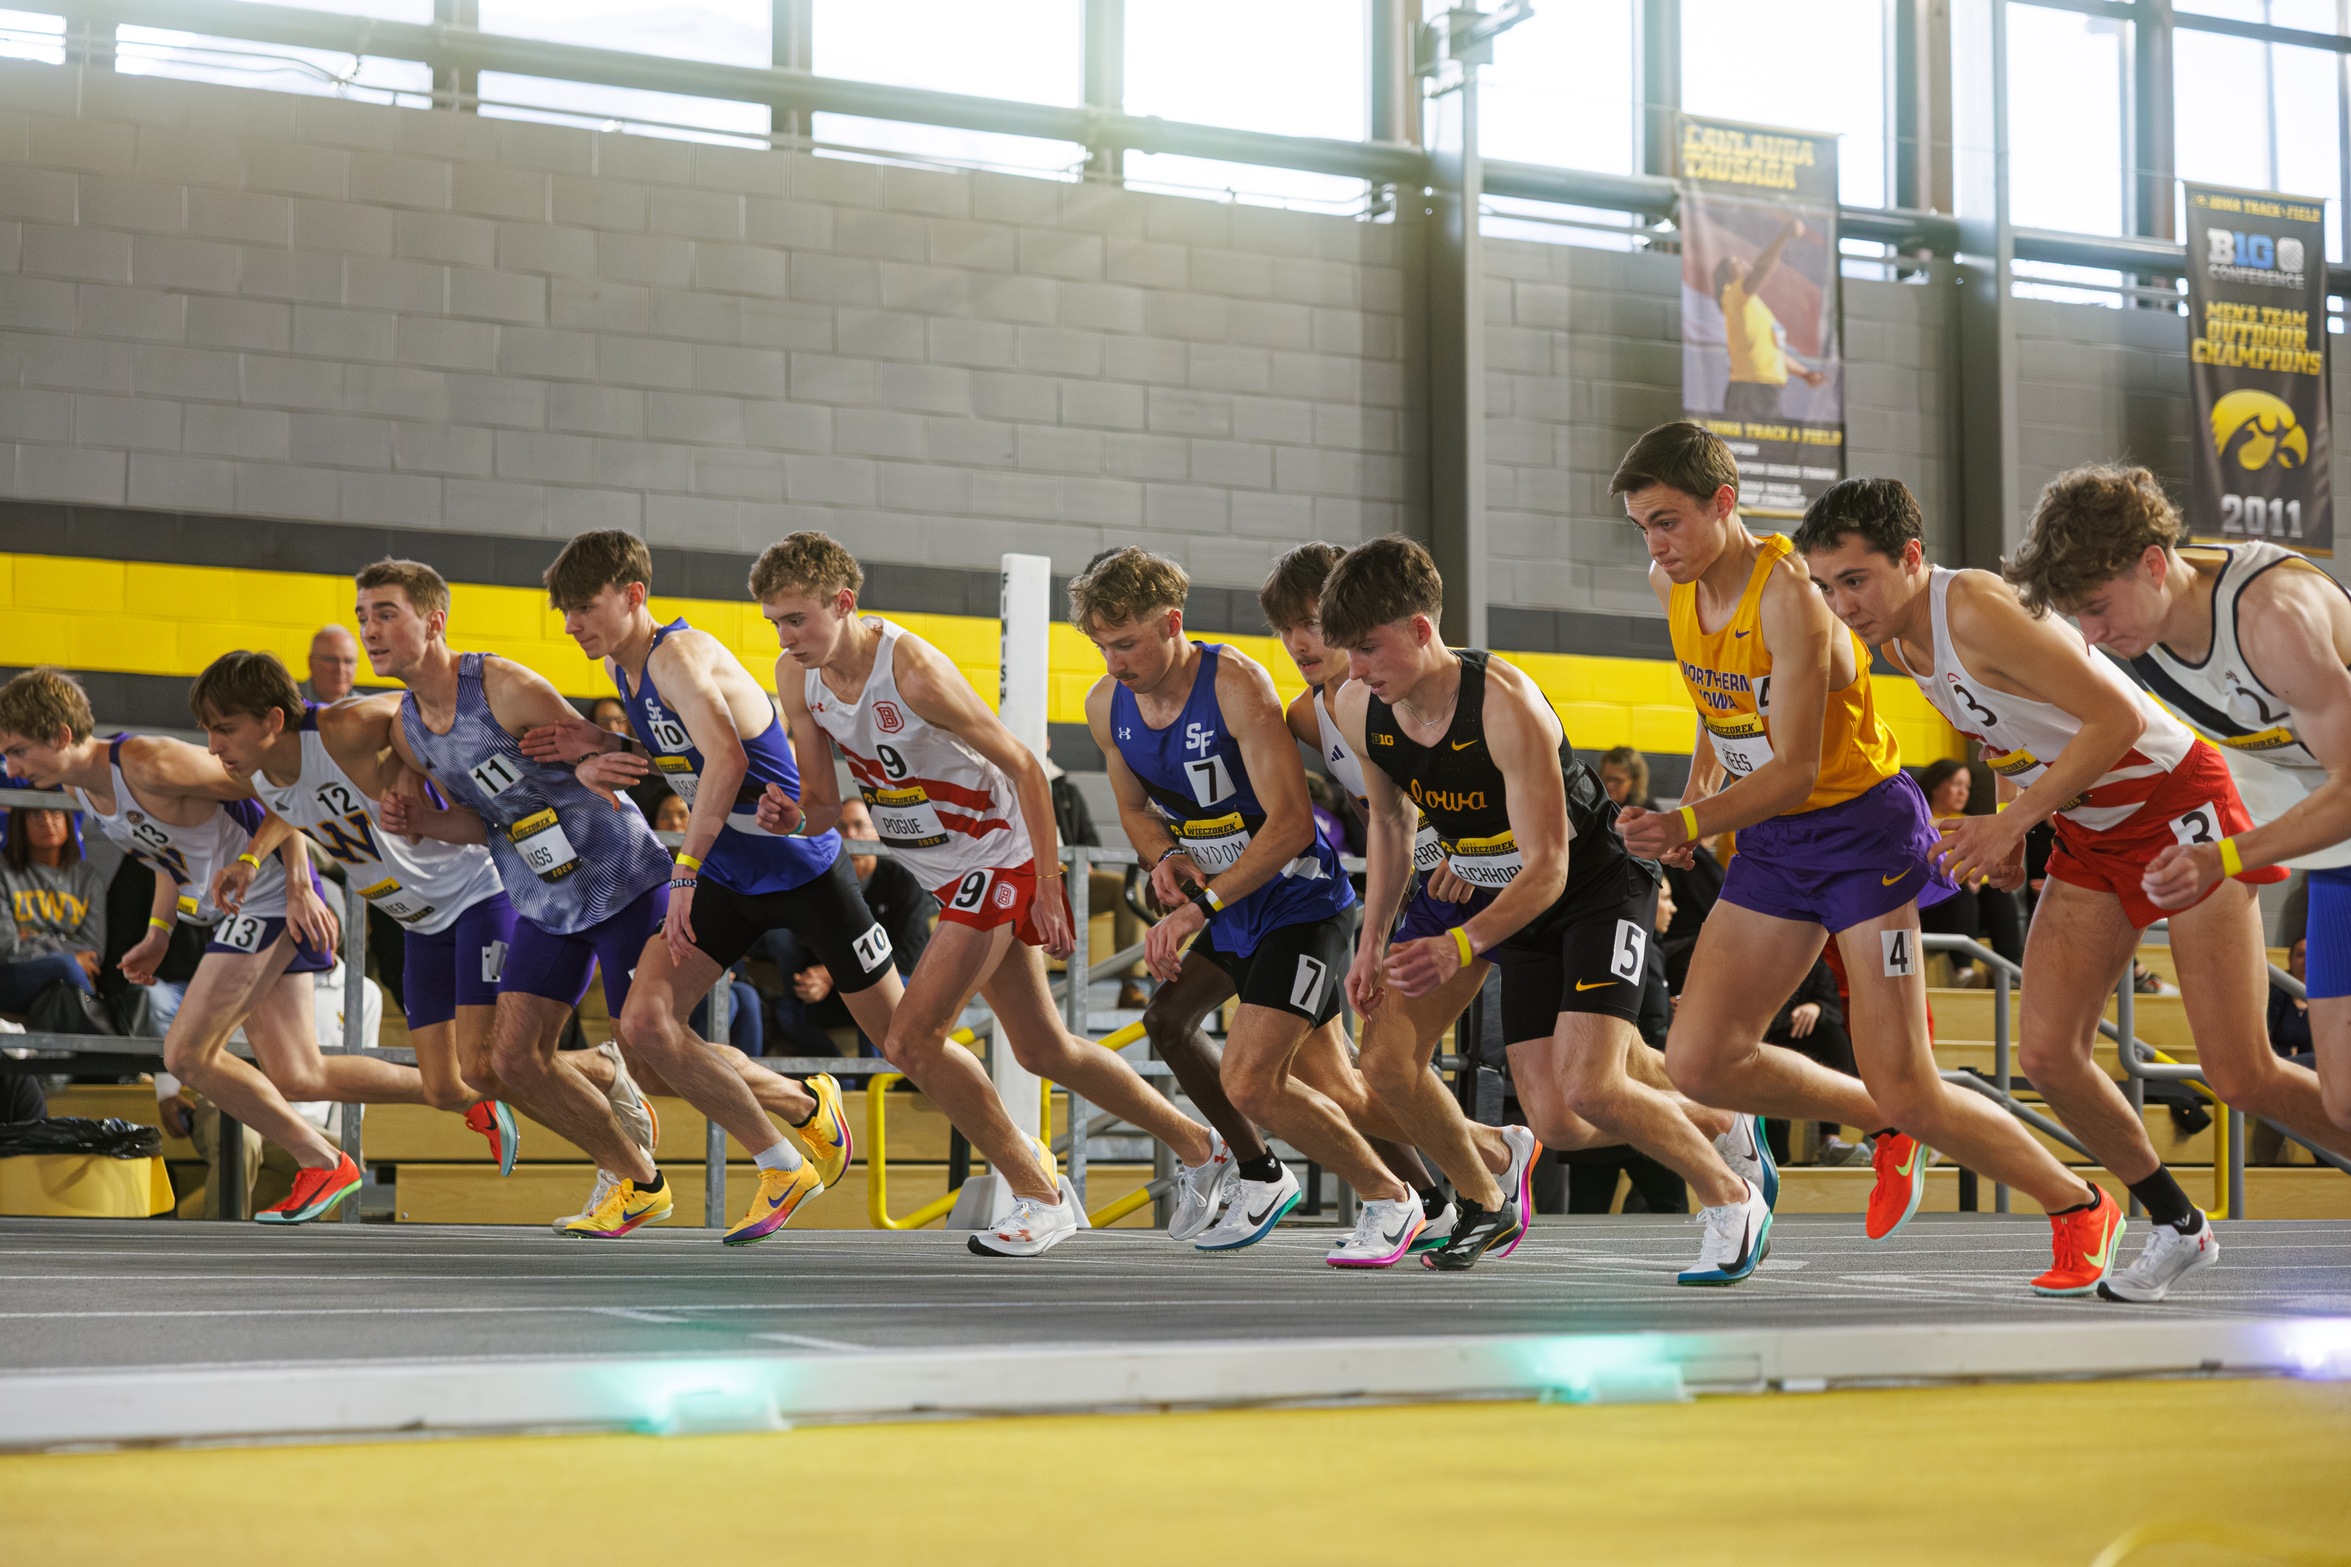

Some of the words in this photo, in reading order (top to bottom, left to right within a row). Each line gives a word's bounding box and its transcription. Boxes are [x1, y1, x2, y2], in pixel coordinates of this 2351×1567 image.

[2208, 264, 2304, 289] CONFERENCE
[2206, 301, 2258, 322] MEN'S
[2261, 306, 2309, 327] TEAM
[2206, 319, 2308, 352] OUTDOOR
[2192, 337, 2322, 375] CHAMPIONS
[2221, 493, 2303, 538] 2011
[1681, 660, 1751, 692] NORTHERN
[645, 698, 663, 721] SF
[1699, 689, 1739, 710] IOWA
[1953, 684, 1997, 727] 3
[2236, 687, 2290, 725] 2
[877, 706, 899, 729] B
[654, 724, 684, 746] 10
[1186, 722, 1215, 758] SF
[475, 759, 514, 793] 11
[876, 745, 907, 778] 9
[1192, 761, 1217, 803] 7
[1405, 778, 1488, 811] Iowa
[317, 787, 359, 816] 12
[133, 823, 169, 848] 13
[883, 817, 924, 834] POGUE
[1187, 822, 1236, 835] WIECZOREK
[2181, 811, 2214, 844] 3
[1460, 840, 1515, 853] WIECZOREK
[955, 871, 986, 908] 9
[1454, 864, 1523, 883] EICHHOR
[222, 914, 258, 948] 13
[859, 927, 886, 961] 10
[1619, 925, 1641, 976] 5
[1890, 931, 1907, 973] 4
[1299, 959, 1321, 1006] 7
